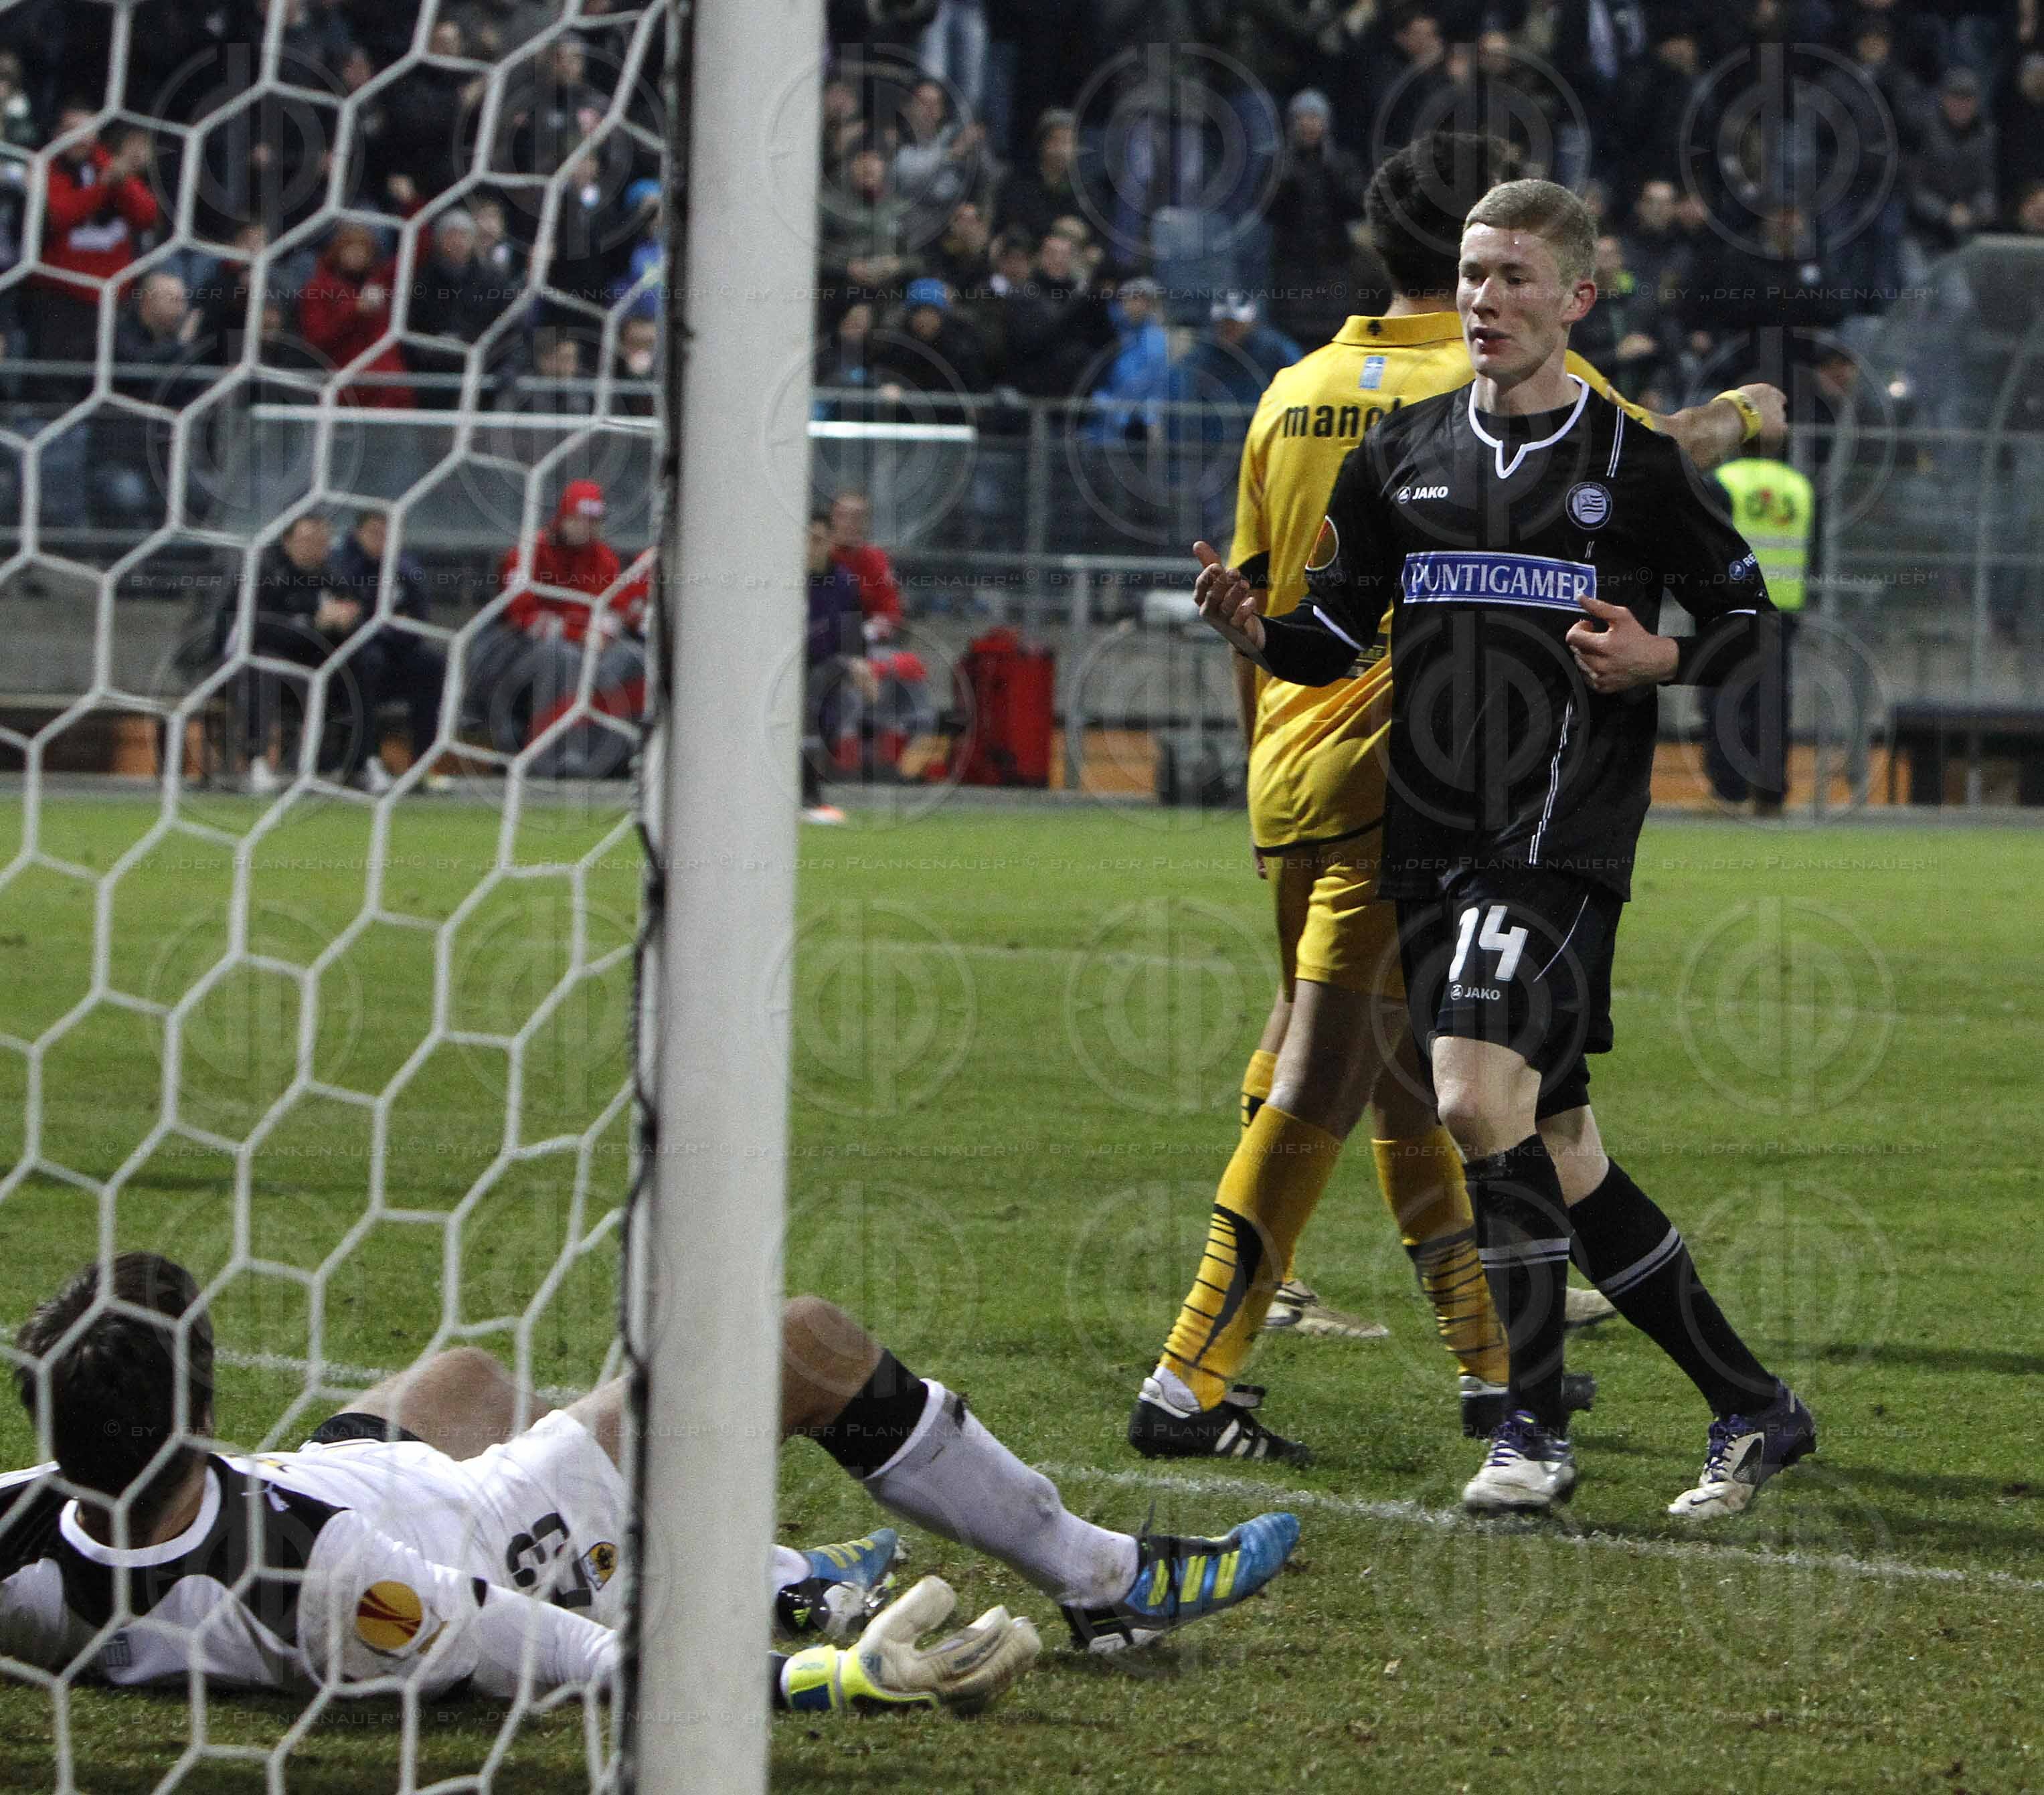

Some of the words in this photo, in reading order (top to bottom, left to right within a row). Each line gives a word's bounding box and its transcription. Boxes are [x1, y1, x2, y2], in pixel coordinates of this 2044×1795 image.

[1283, 398, 1401, 437] mano
[1412, 486, 1448, 500] JAKO
[1410, 563, 1588, 601] PUNTIGAMER
[1448, 905, 1529, 982] 14
[1464, 987, 1501, 1001] JAKO
